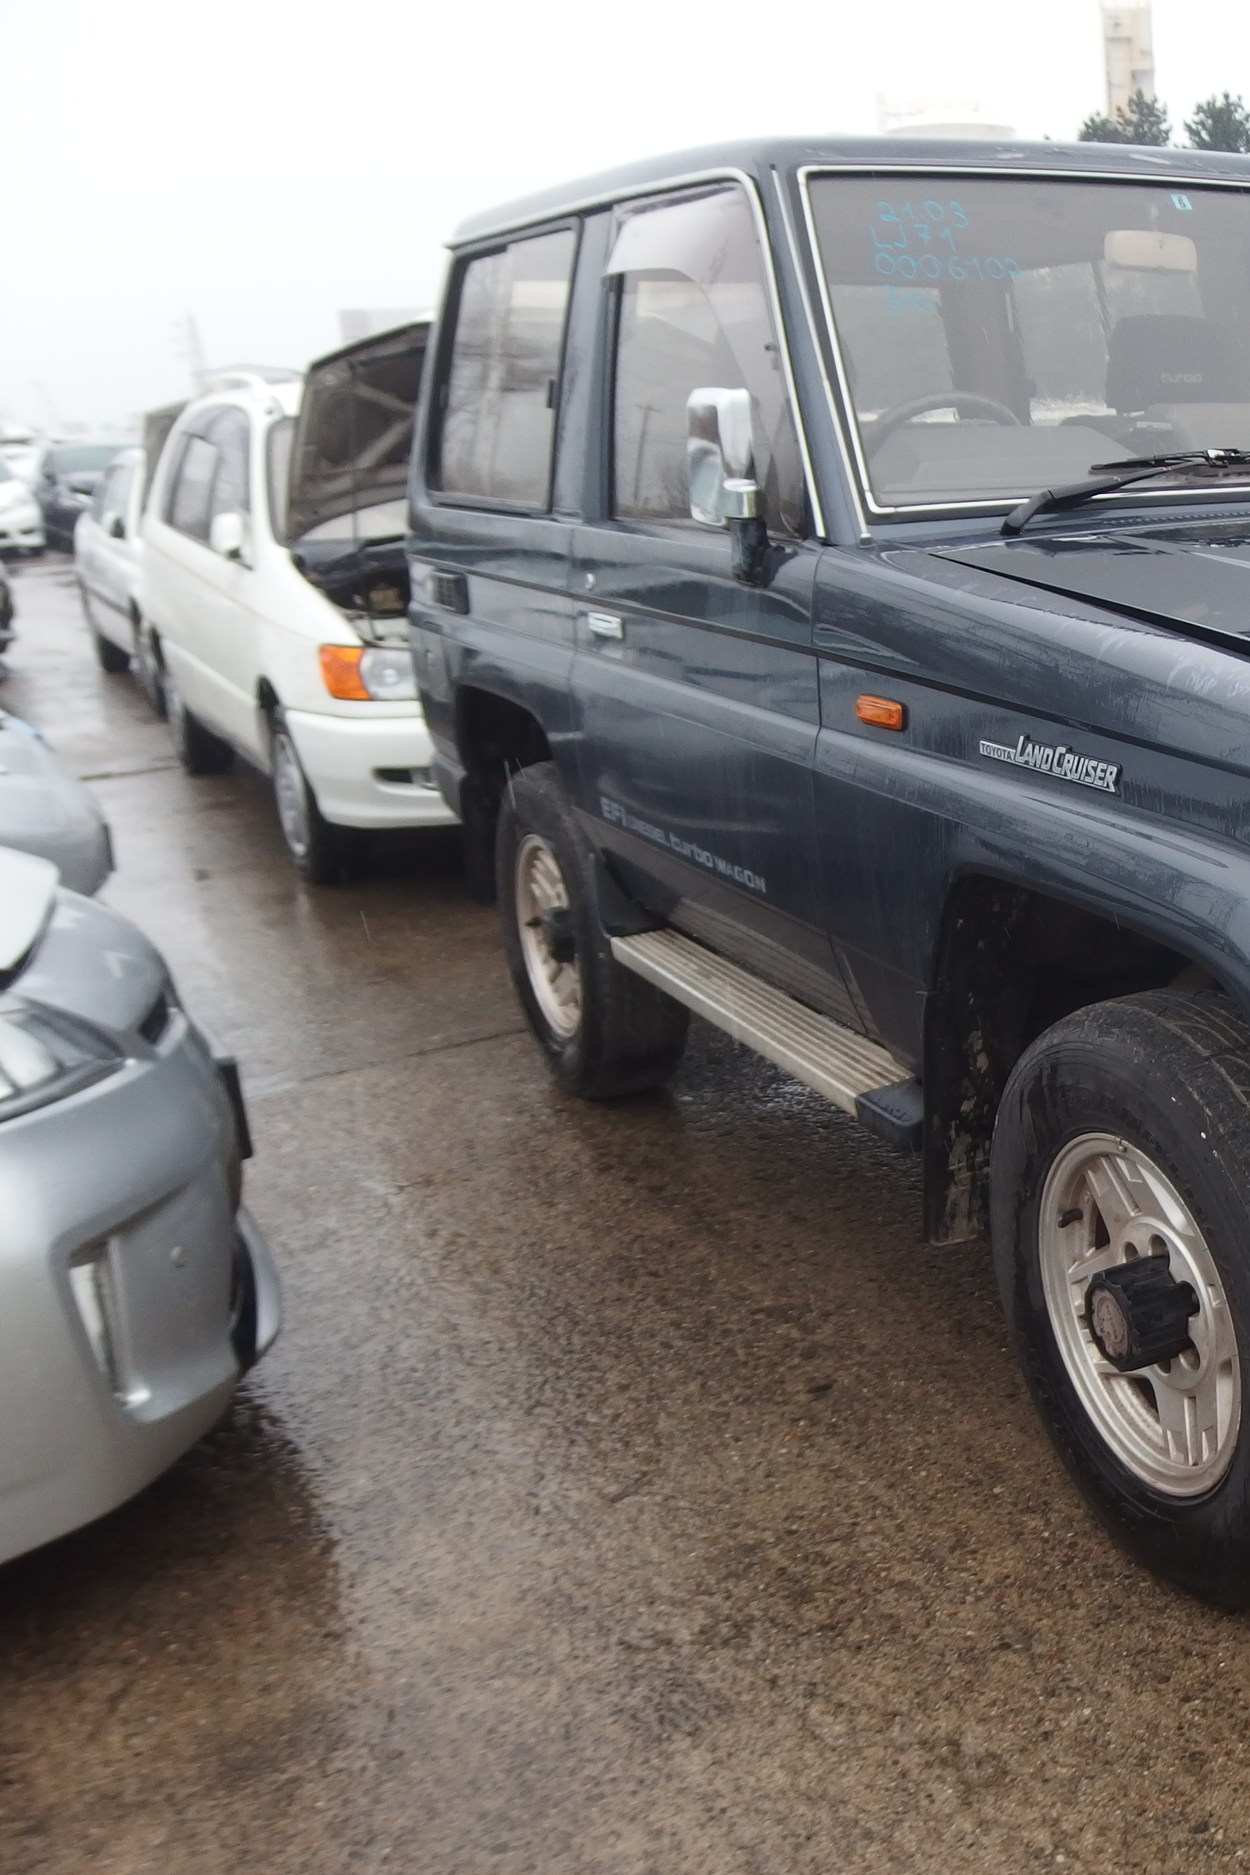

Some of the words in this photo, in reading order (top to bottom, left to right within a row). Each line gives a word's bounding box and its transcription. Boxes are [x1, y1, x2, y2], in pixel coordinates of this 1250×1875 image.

[876, 199, 970, 228] 2103
[980, 741, 1014, 762] TOYOTA
[600, 796, 628, 828] EFI
[713, 854, 768, 894] WAGON
